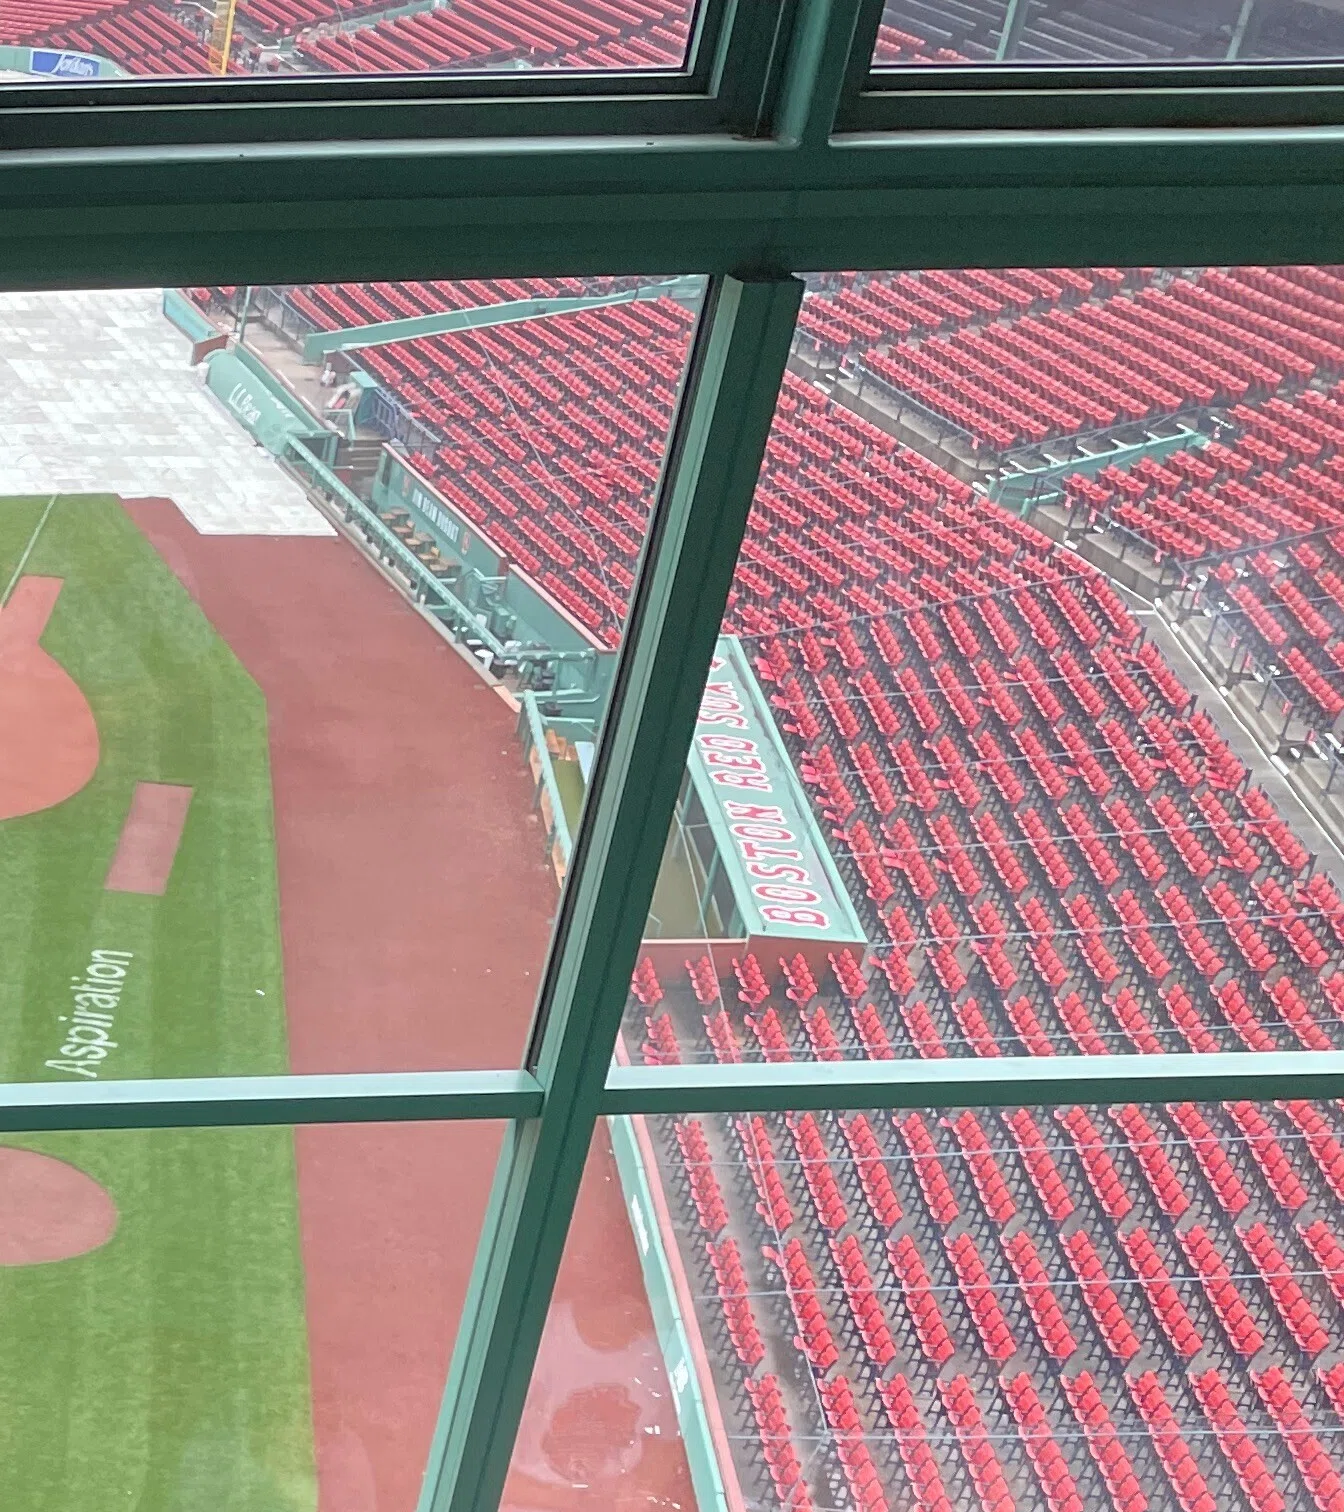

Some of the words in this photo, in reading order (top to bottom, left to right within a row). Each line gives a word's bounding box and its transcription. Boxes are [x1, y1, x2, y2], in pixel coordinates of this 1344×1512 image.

[695, 733, 773, 793] RED
[723, 800, 831, 929] BOSTON
[45, 949, 134, 1079] Aspiration
